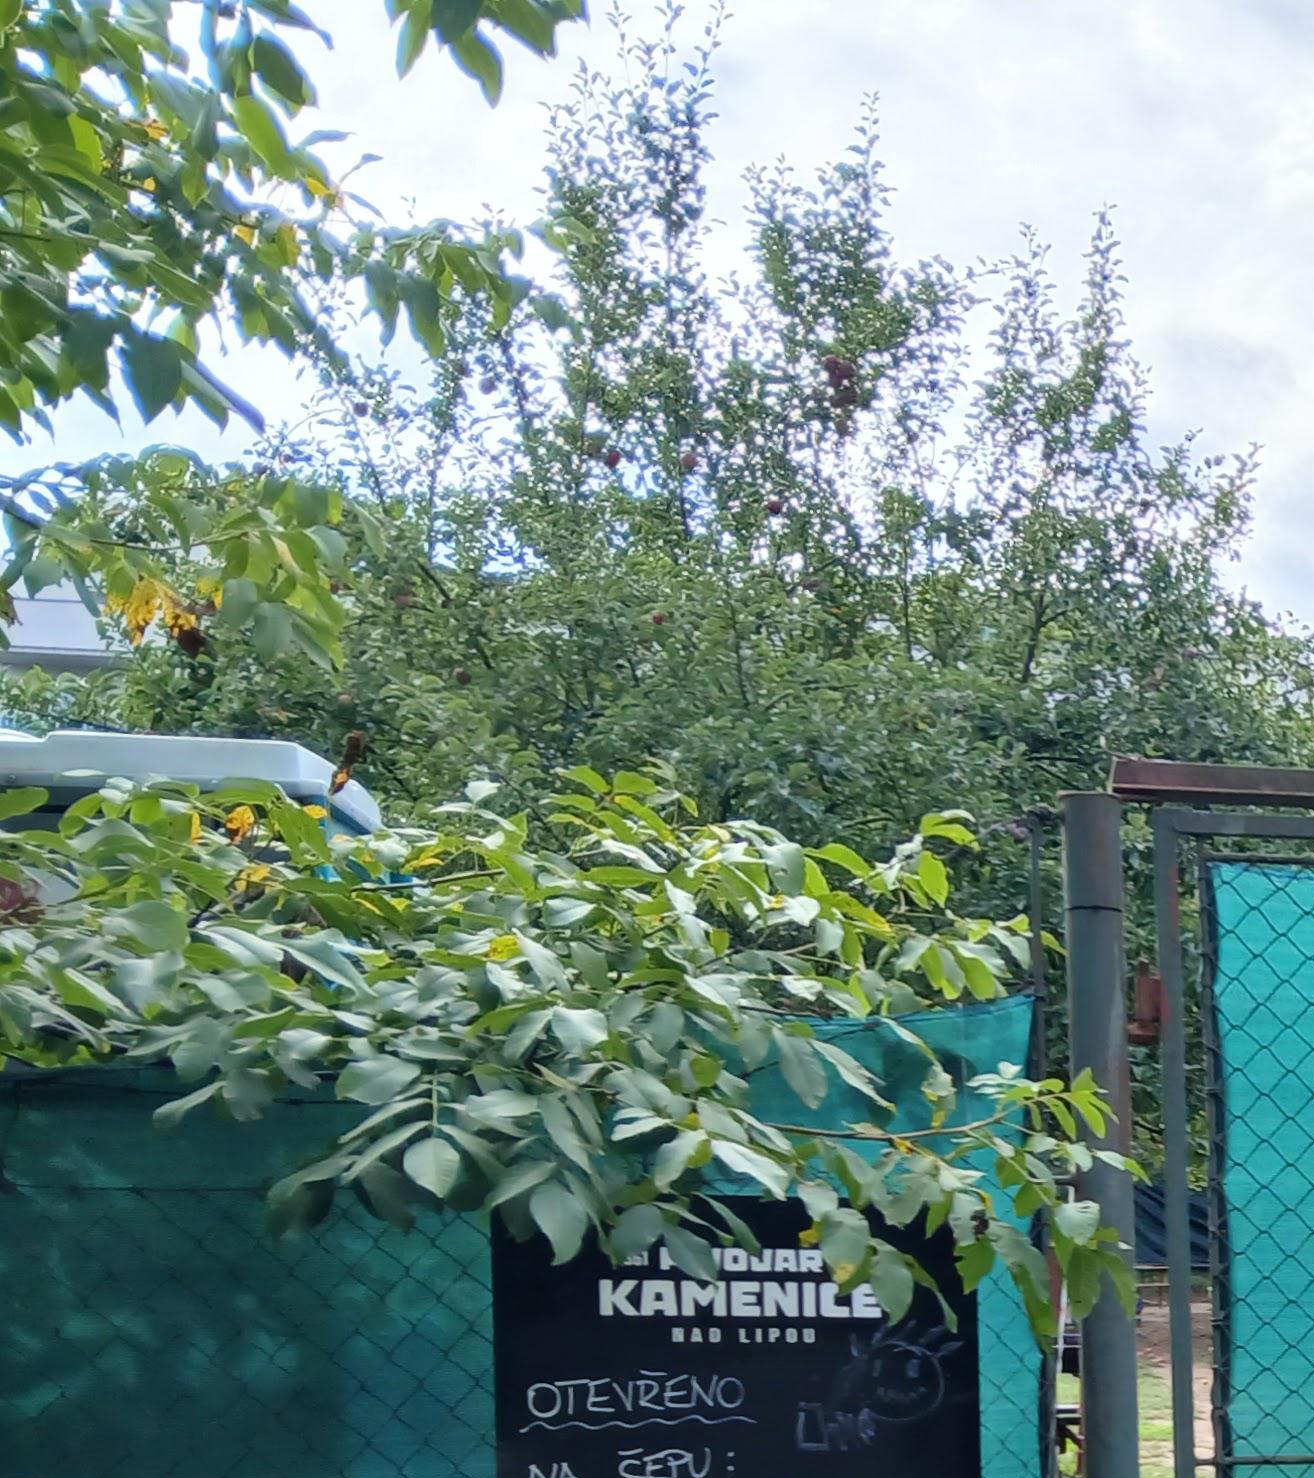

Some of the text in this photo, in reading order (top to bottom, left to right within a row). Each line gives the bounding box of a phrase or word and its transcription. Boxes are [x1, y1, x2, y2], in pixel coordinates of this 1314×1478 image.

[599, 1278, 883, 1319] KAMENICE
[671, 1326, 817, 1344] NAD LIPOU
[527, 1369, 746, 1418] OTEVŘENO
